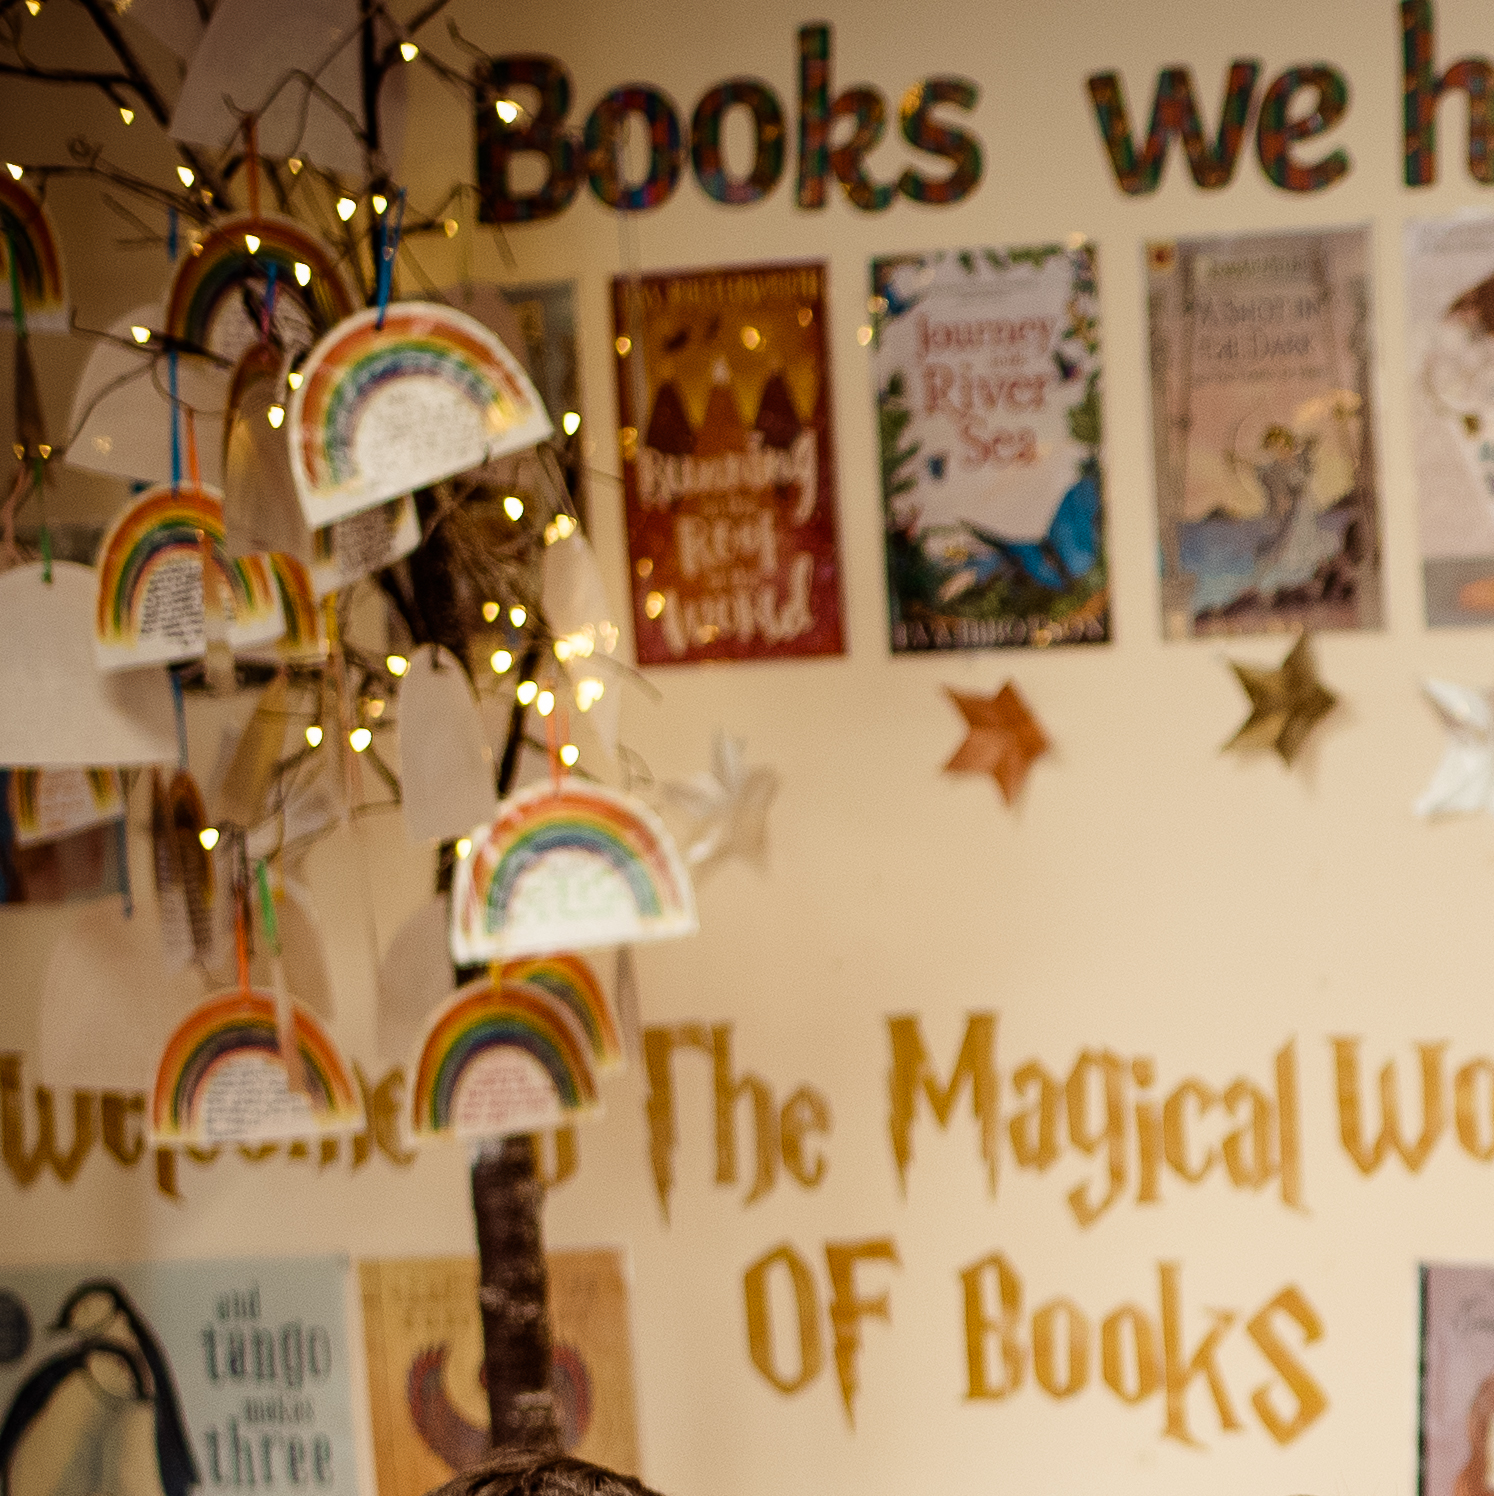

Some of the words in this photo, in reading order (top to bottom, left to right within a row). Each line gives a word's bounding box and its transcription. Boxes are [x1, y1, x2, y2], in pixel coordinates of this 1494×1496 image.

[474, 24, 986, 225] Books
[1085, 58, 1352, 196] we
[922, 363, 1047, 414] River
[960, 419, 1037, 467] Sea
[643, 1016, 833, 1228] The
[883, 1010, 1311, 1231] Magical
[214, 1280, 263, 1324] and
[744, 1239, 903, 1432] OF
[199, 1315, 332, 1385] tango
[204, 1427, 334, 1493] three
